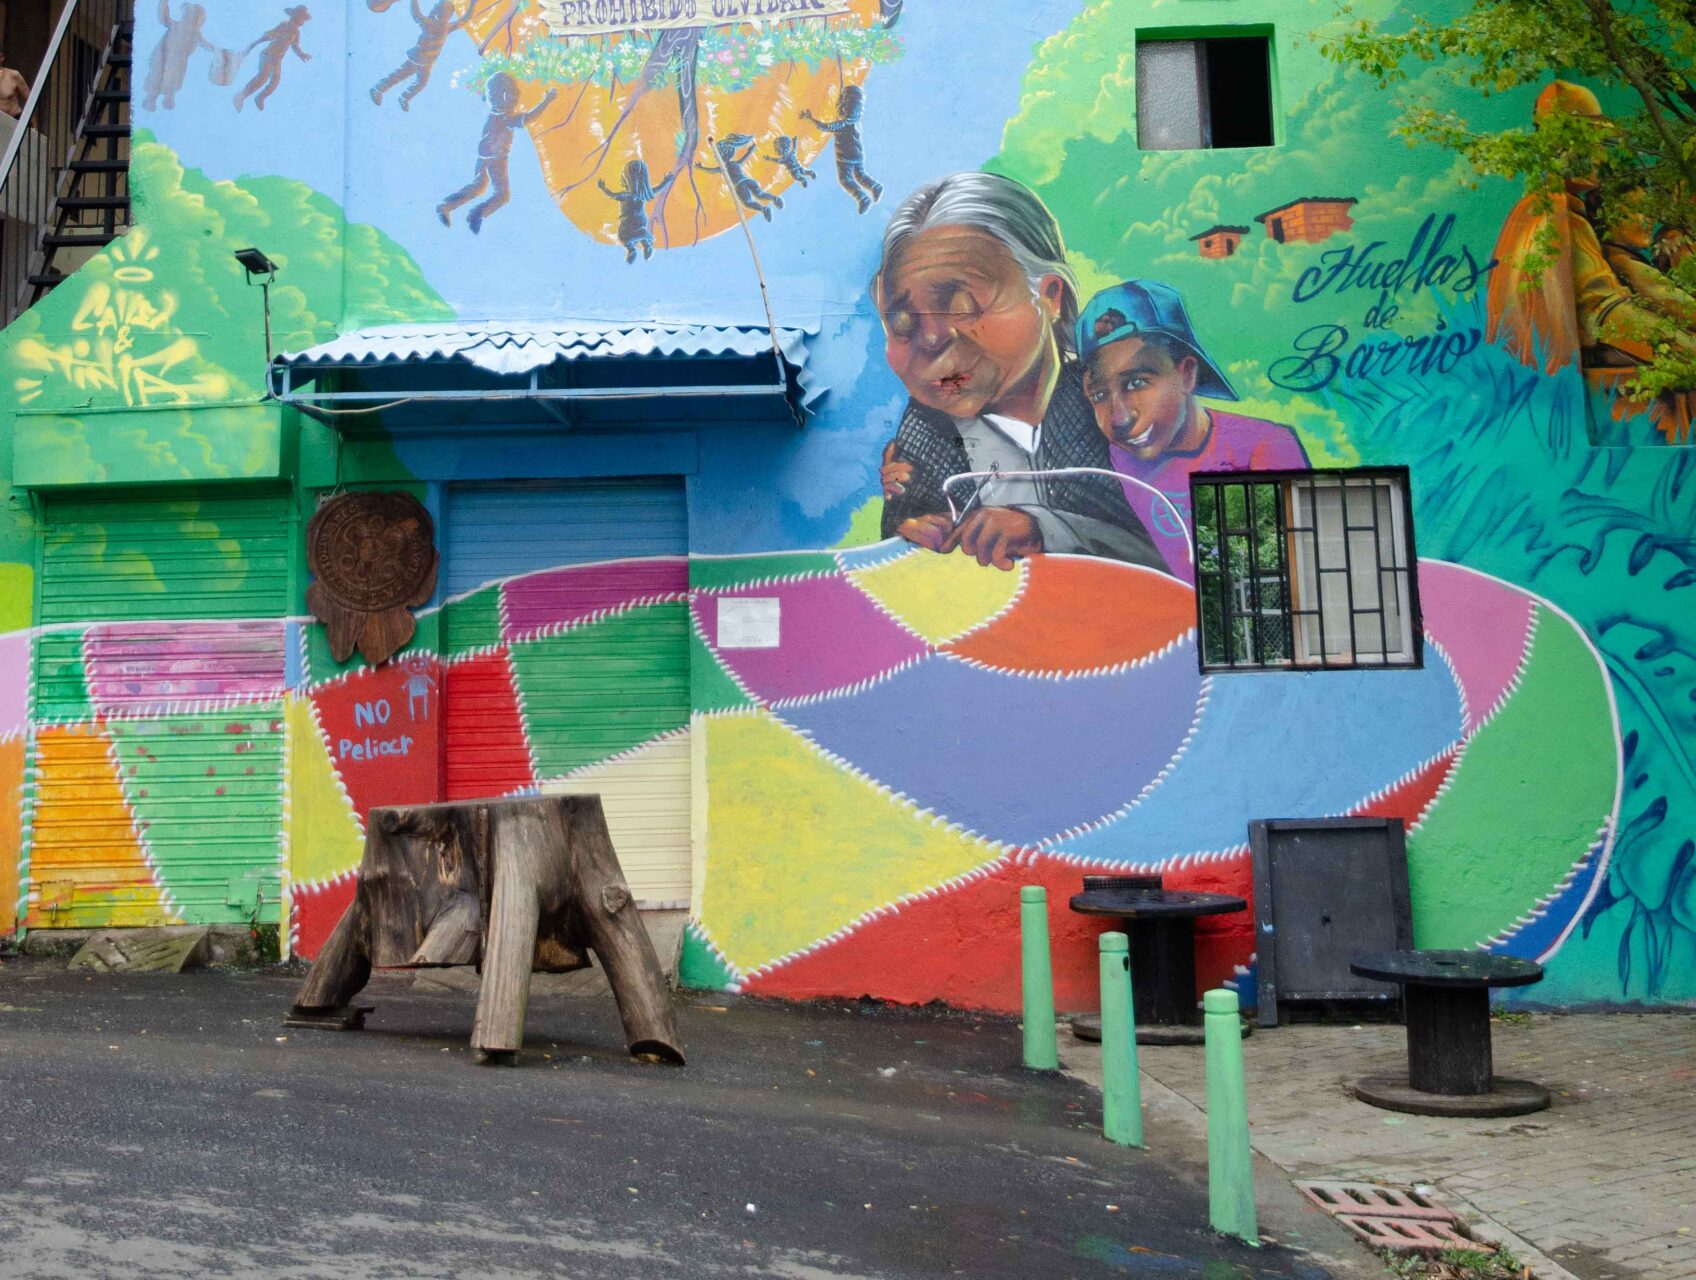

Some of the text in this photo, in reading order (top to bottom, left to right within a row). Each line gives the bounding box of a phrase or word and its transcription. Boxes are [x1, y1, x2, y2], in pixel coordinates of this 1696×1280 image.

[1292, 212, 1500, 303] Huellas
[1363, 289, 1400, 331] de
[1267, 313, 1482, 392] Barrio
[354, 699, 391, 728] NO
